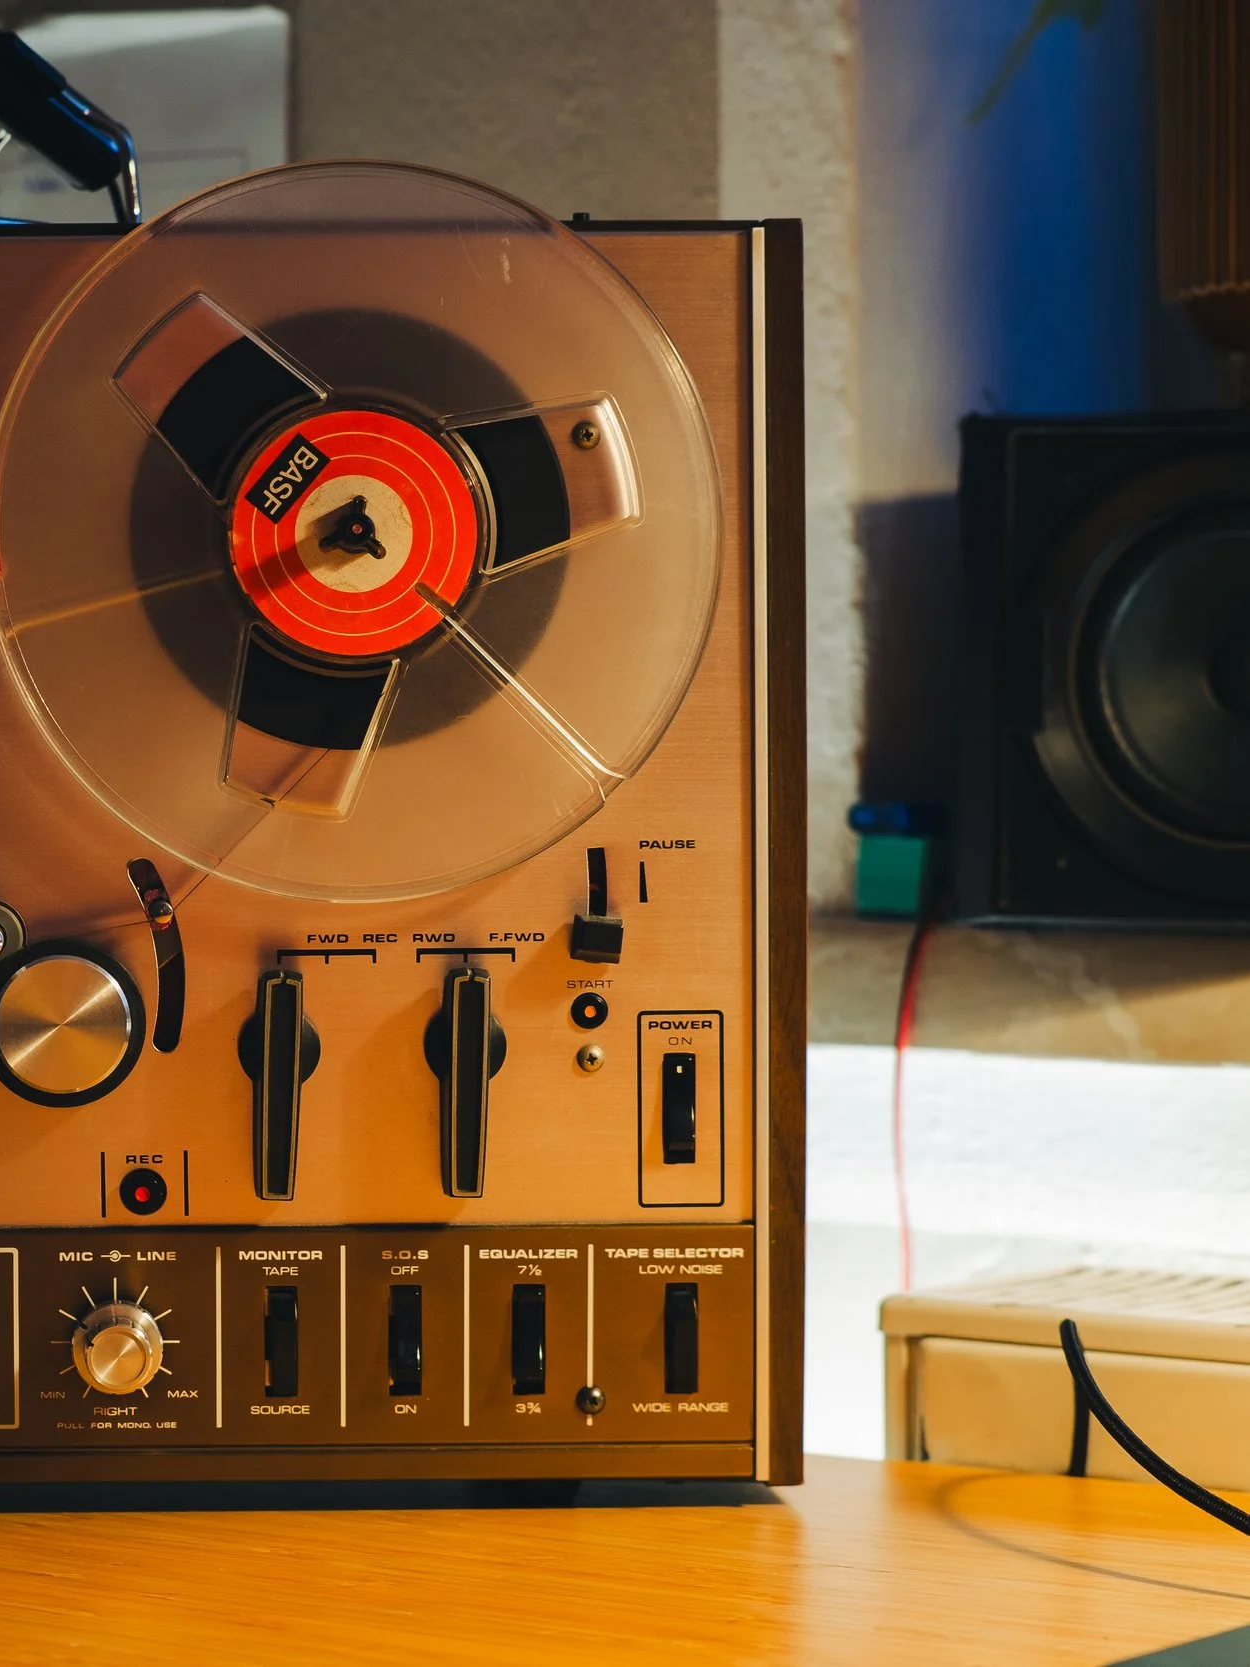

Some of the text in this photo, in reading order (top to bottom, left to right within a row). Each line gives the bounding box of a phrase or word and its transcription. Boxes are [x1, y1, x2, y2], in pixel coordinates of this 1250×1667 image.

[263, 445, 319, 515] BASF
[639, 839, 696, 850] PAUSE
[307, 933, 398, 944] FWD REC
[412, 932, 545, 944] RWD F.FWD
[566, 979, 614, 989] START
[648, 1020, 713, 1031] POWER
[668, 1036, 693, 1047] ON
[125, 1154, 163, 1164] REC
[59, 1251, 177, 1262] MIC LINE
[238, 1250, 323, 1261] MONITOR
[381, 1249, 429, 1260] S.O.S
[479, 1248, 578, 1260] EQUALIZER
[604, 1247, 744, 1259] TAPE SELECTOR
[262, 1266, 299, 1276] TAPE
[390, 1266, 419, 1275] OFF
[639, 1264, 723, 1275] LOW NOISE
[40, 1390, 66, 1400] MIN
[167, 1389, 199, 1399] MAX
[93, 1406, 138, 1416] RIGHT
[250, 1405, 310, 1415] SOURCE
[394, 1404, 417, 1414] ON
[632, 1402, 729, 1413] WIDE RANGE
[56, 1421, 85, 1429] PULL
[90, 1421, 112, 1429] FOR
[156, 1420, 177, 1429] USE
